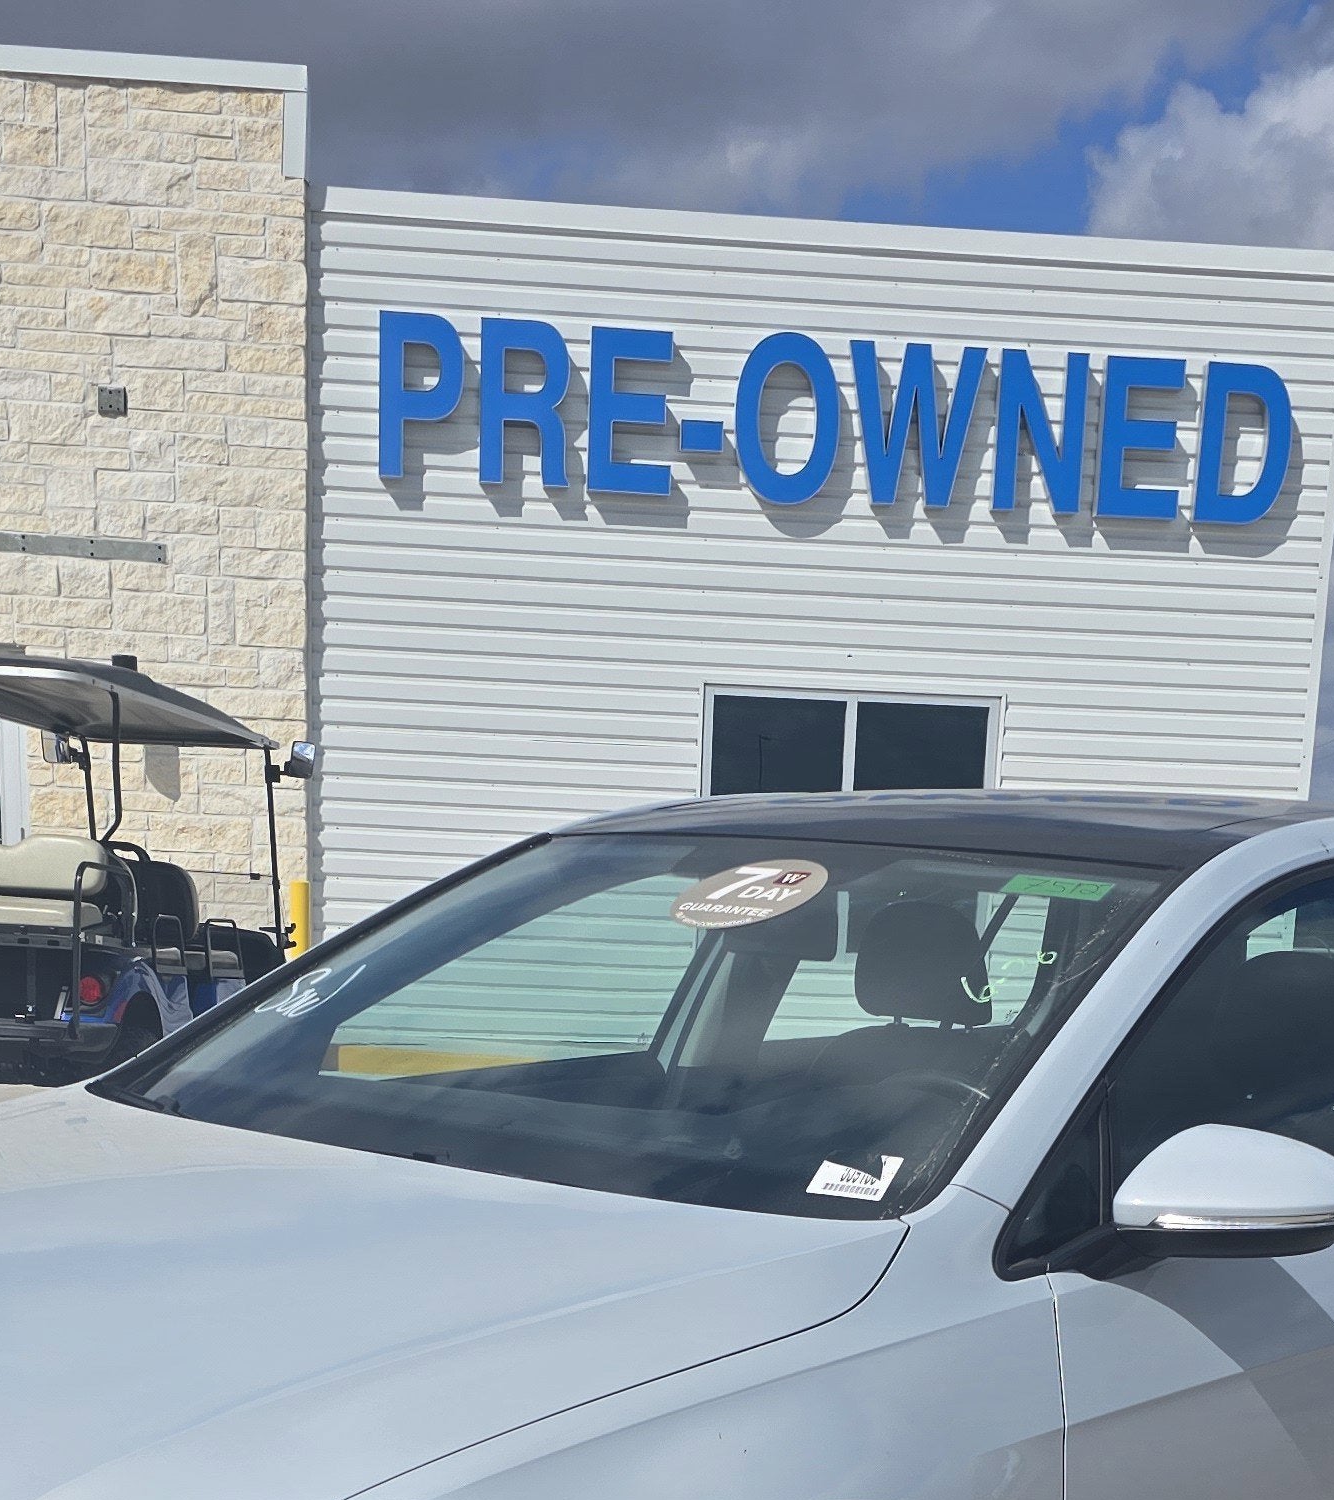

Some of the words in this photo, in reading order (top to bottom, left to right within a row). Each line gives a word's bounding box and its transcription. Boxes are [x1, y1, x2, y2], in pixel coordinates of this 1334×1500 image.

[378, 309, 1294, 525] PRE-OWNED
[705, 866, 782, 900] 7
[737, 885, 801, 901] DAY
[679, 902, 774, 918] GUARANTEE
